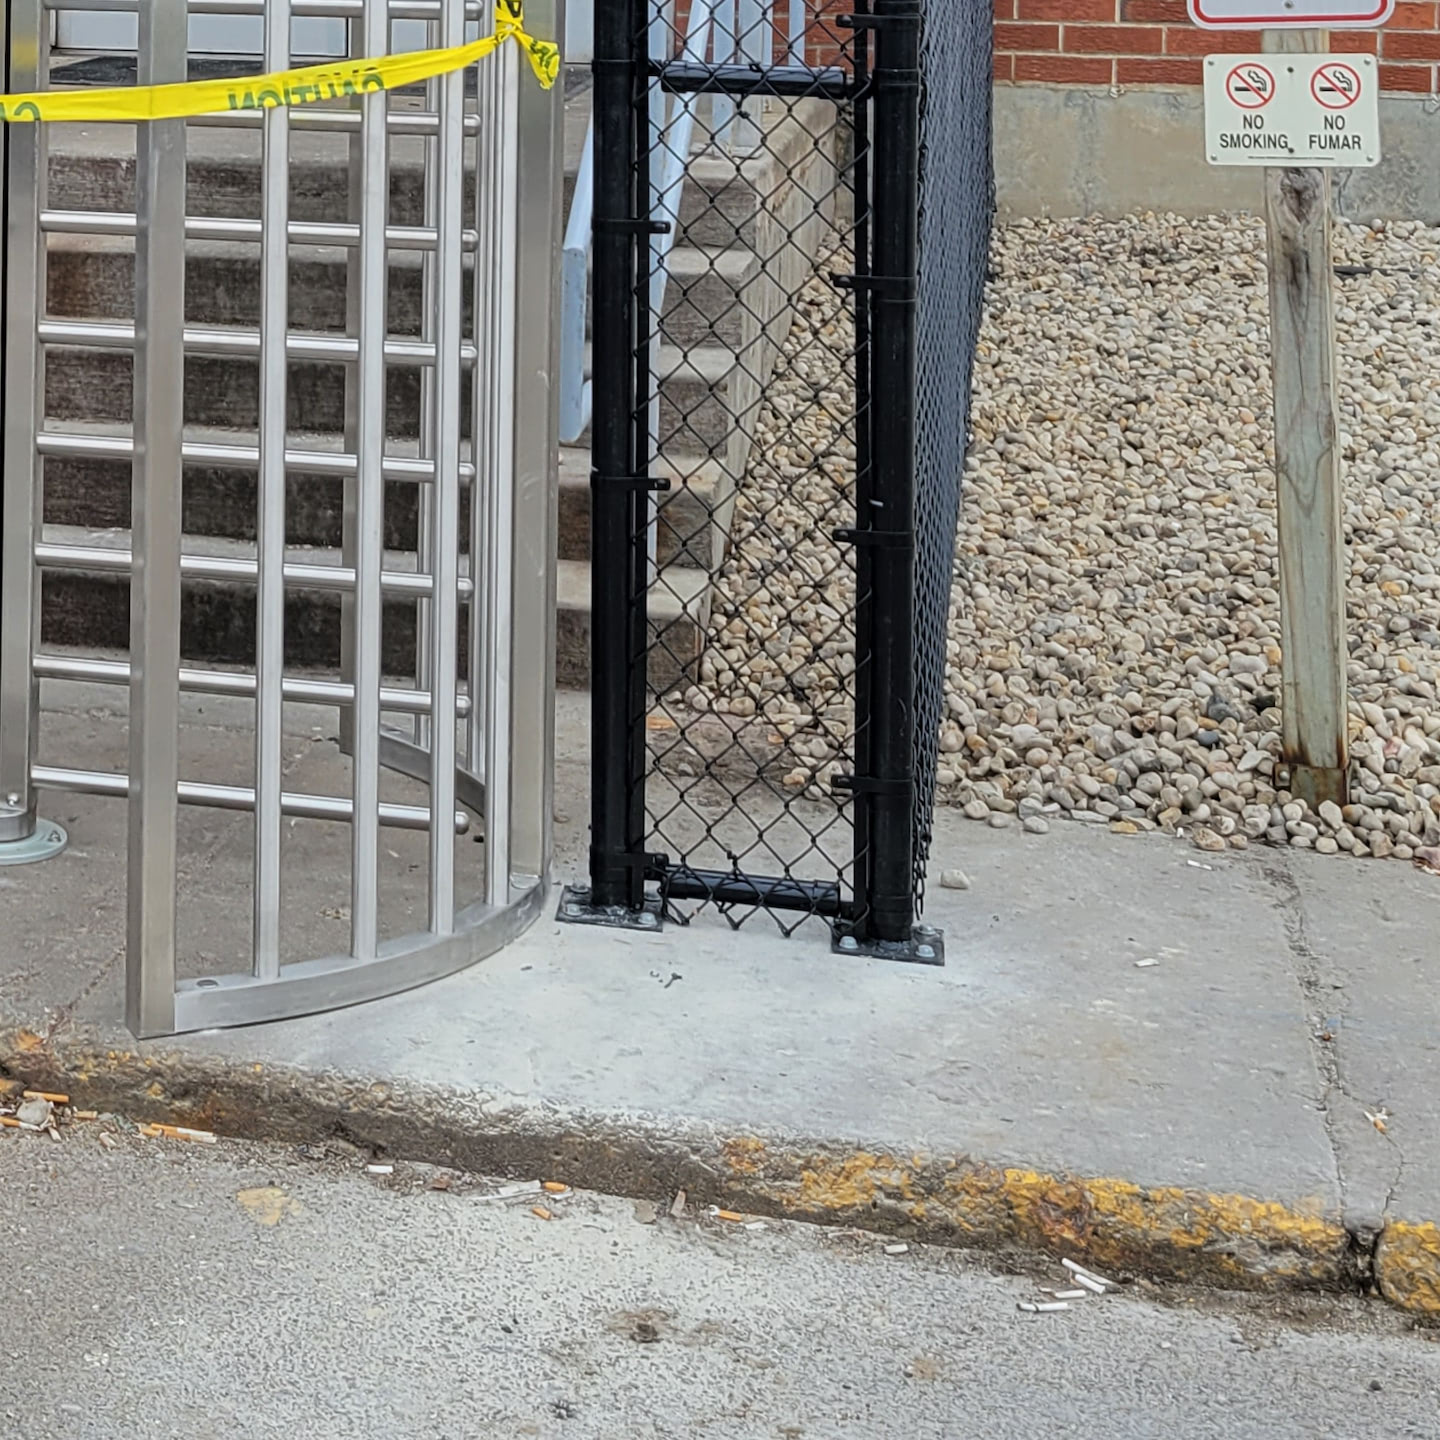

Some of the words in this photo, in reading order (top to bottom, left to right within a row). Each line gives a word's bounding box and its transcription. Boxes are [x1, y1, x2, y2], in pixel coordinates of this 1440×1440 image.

[1242, 115, 1264, 130] NO
[1324, 115, 1345, 131] NO
[1219, 134, 1289, 149] SMOKING
[1309, 135, 1362, 150] FUMAR
